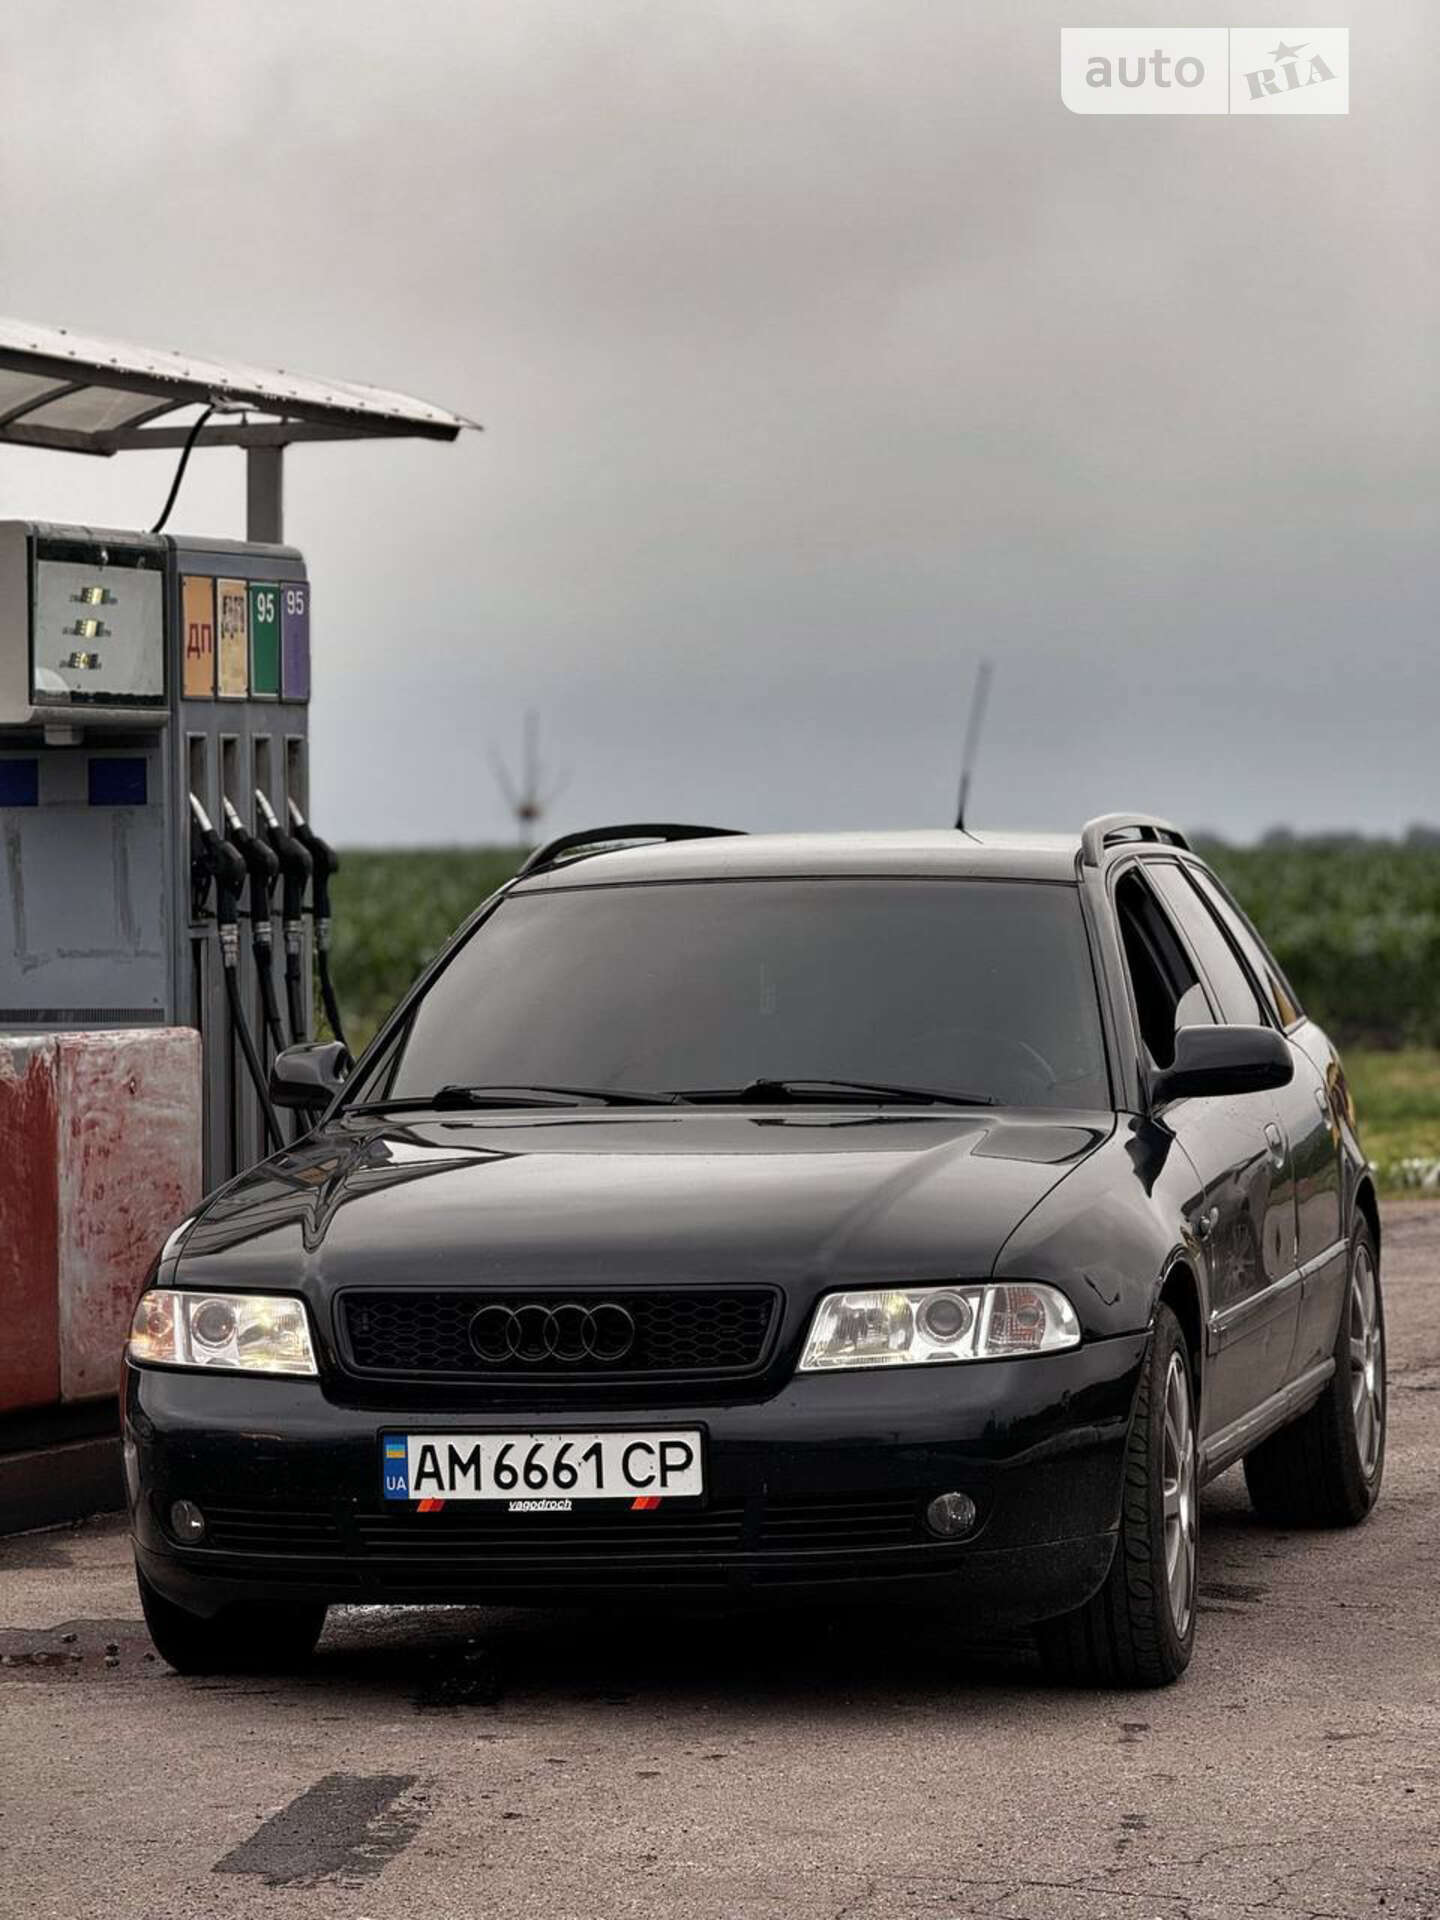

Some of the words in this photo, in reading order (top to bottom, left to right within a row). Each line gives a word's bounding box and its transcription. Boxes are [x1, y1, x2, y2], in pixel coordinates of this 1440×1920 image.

[256, 593, 274, 623] 95
[286, 590, 304, 615] 95
[187, 623, 212, 659] ДП
[414, 1444, 481, 1491] AM
[493, 1442, 604, 1489] 6661
[622, 1440, 694, 1488] CP
[386, 1476, 407, 1491] UA
[508, 1499, 572, 1511] vagodroch
